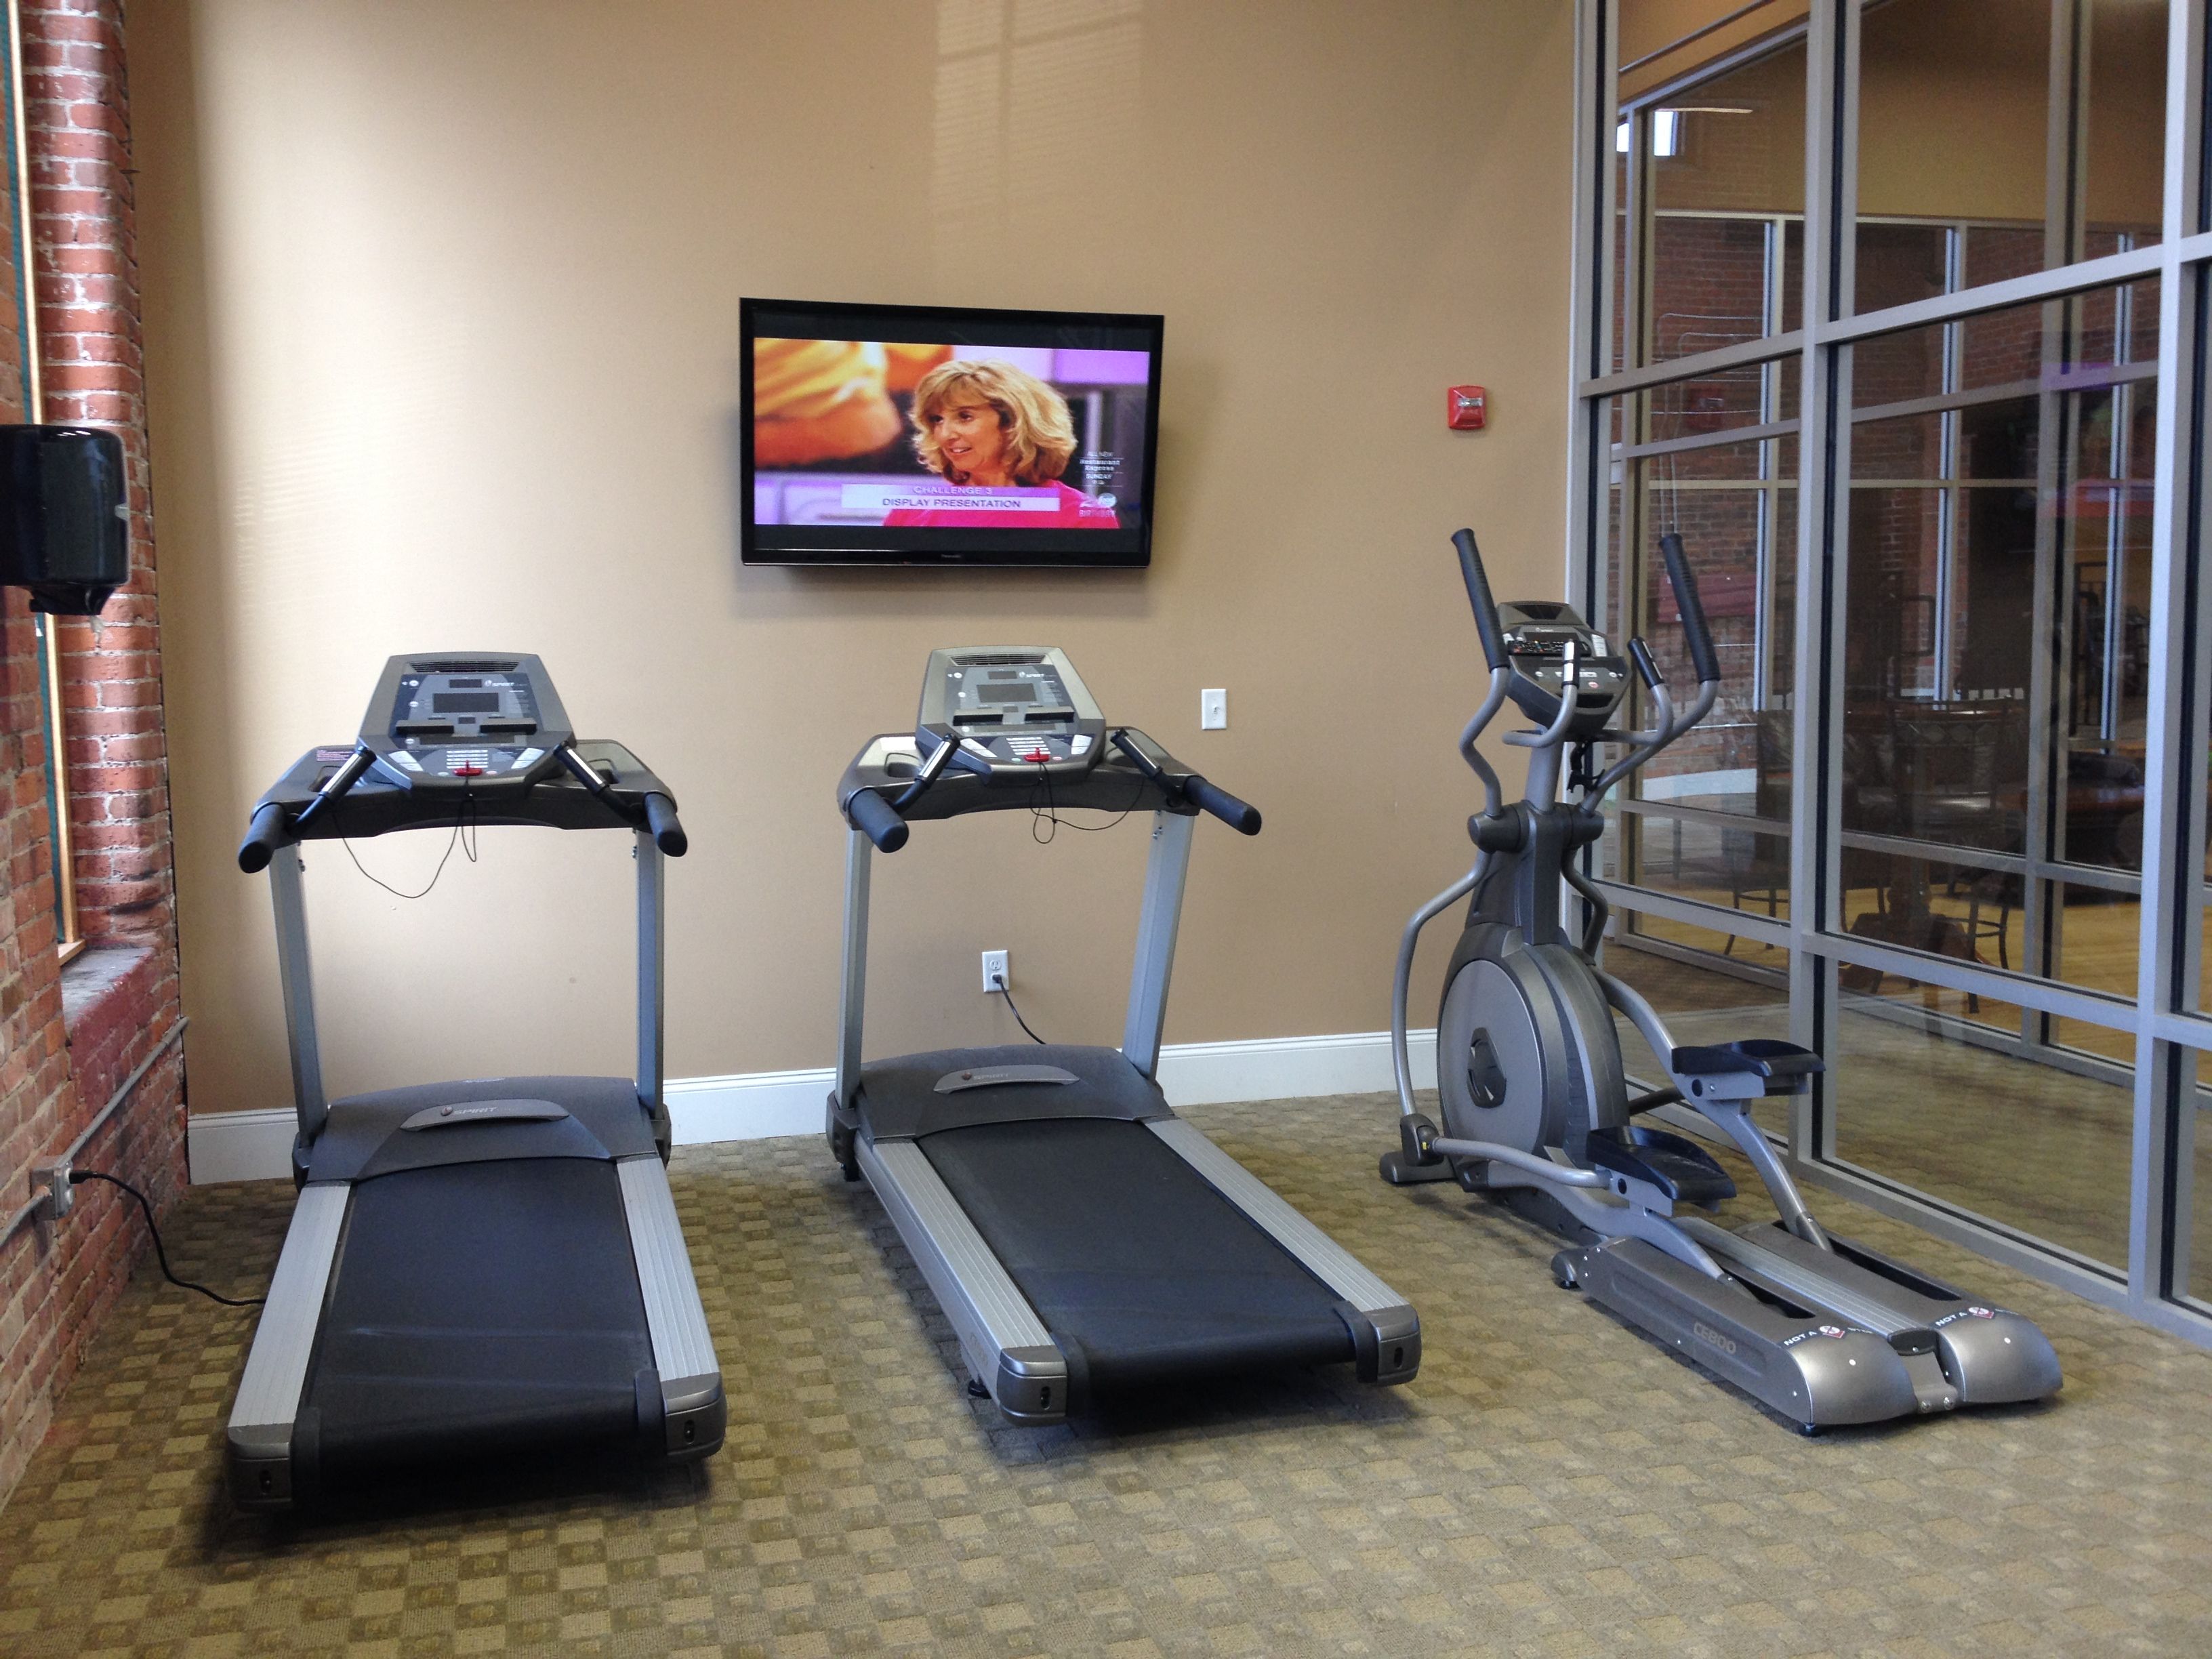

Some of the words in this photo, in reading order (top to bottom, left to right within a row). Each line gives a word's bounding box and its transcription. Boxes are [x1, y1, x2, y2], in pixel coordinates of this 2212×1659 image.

[914, 486, 982, 495] CHALLENGE
[882, 497, 928, 506] DISPLAY
[933, 499, 1021, 508] PRESENTATION
[454, 1106, 497, 1115] SPIRIT
[1936, 1314, 1957, 1326] NOT
[1694, 1322, 1736, 1354] CE800
[1783, 1334, 1806, 1346] NOT
